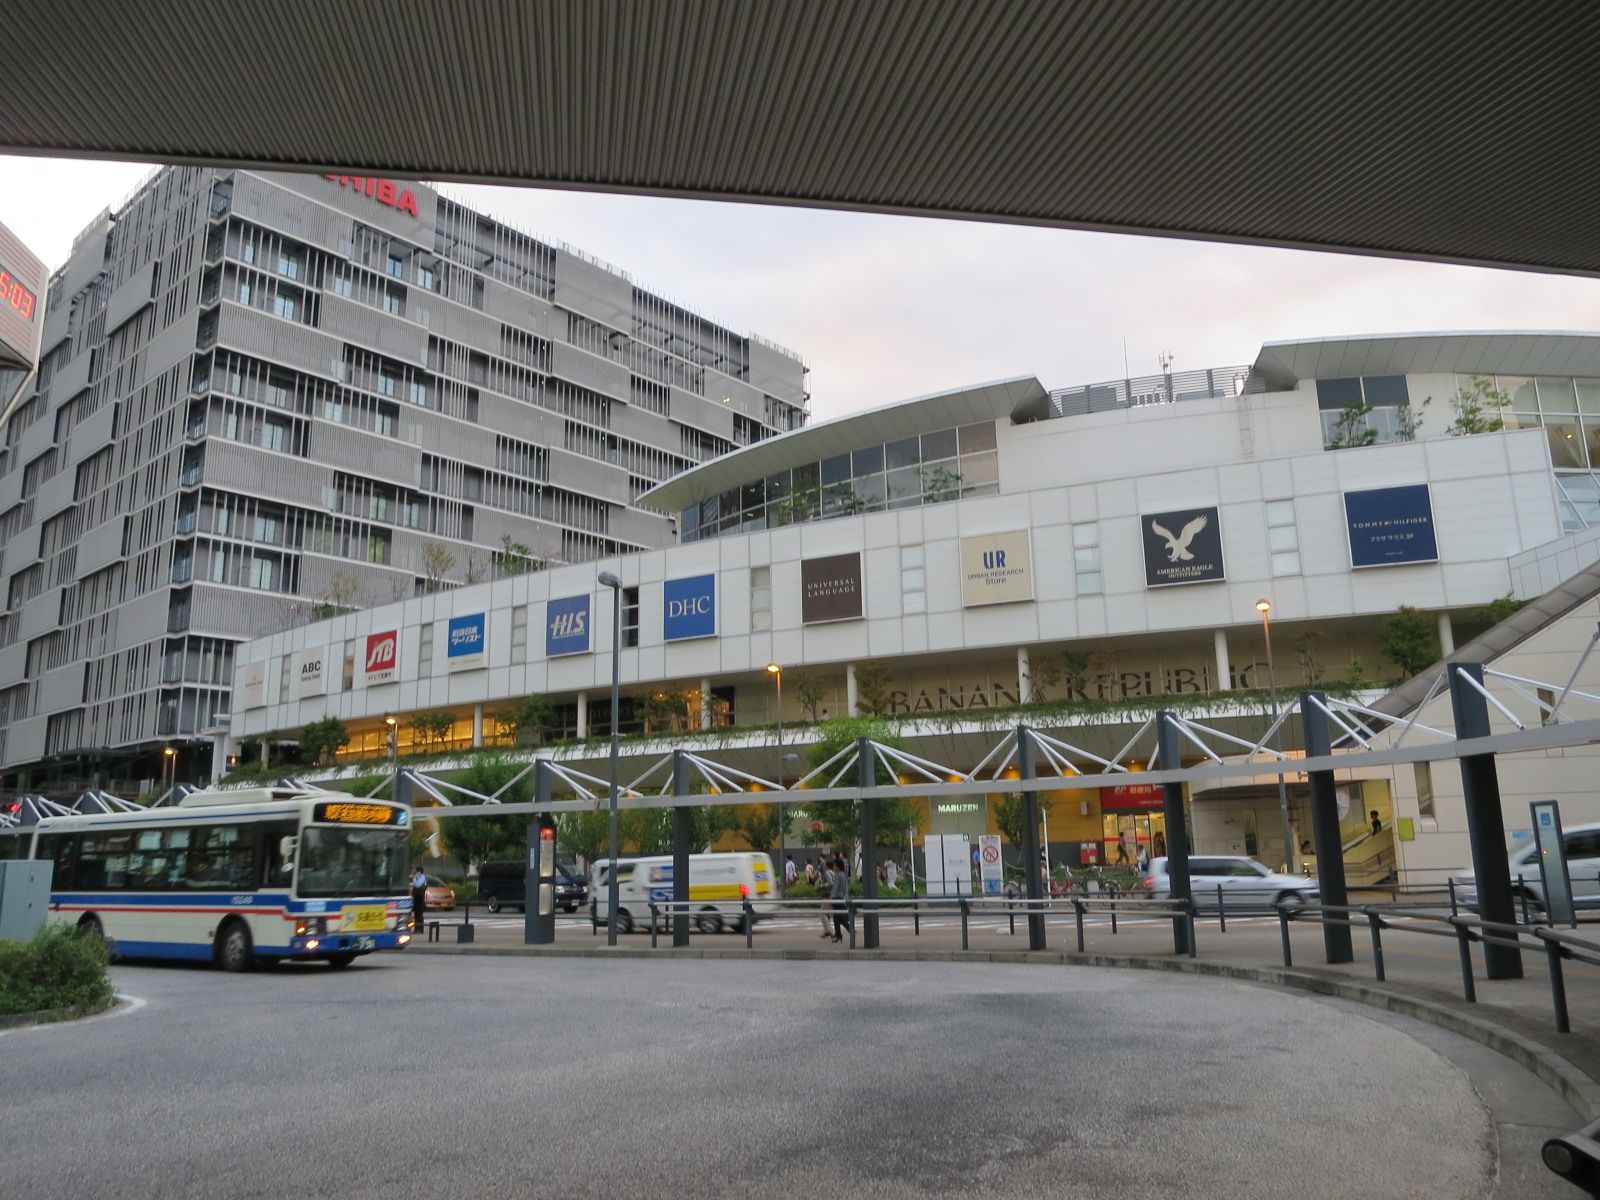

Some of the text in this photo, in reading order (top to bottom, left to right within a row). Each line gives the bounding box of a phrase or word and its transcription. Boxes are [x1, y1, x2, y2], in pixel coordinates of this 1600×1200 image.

[1353, 517, 1428, 529] TOMMY HILFIGER
[983, 550, 1006, 569] UR
[1156, 563, 1214, 576] AMERICAN EAGLE
[807, 577, 855, 590] UNIVERSAL
[985, 577, 1007, 586] Store
[808, 585, 856, 598] LANGUAGE
[668, 596, 711, 618] DHC
[366, 638, 395, 669] JTB
[301, 660, 321, 674] ABC
[937, 803, 979, 813] MARUZEN
